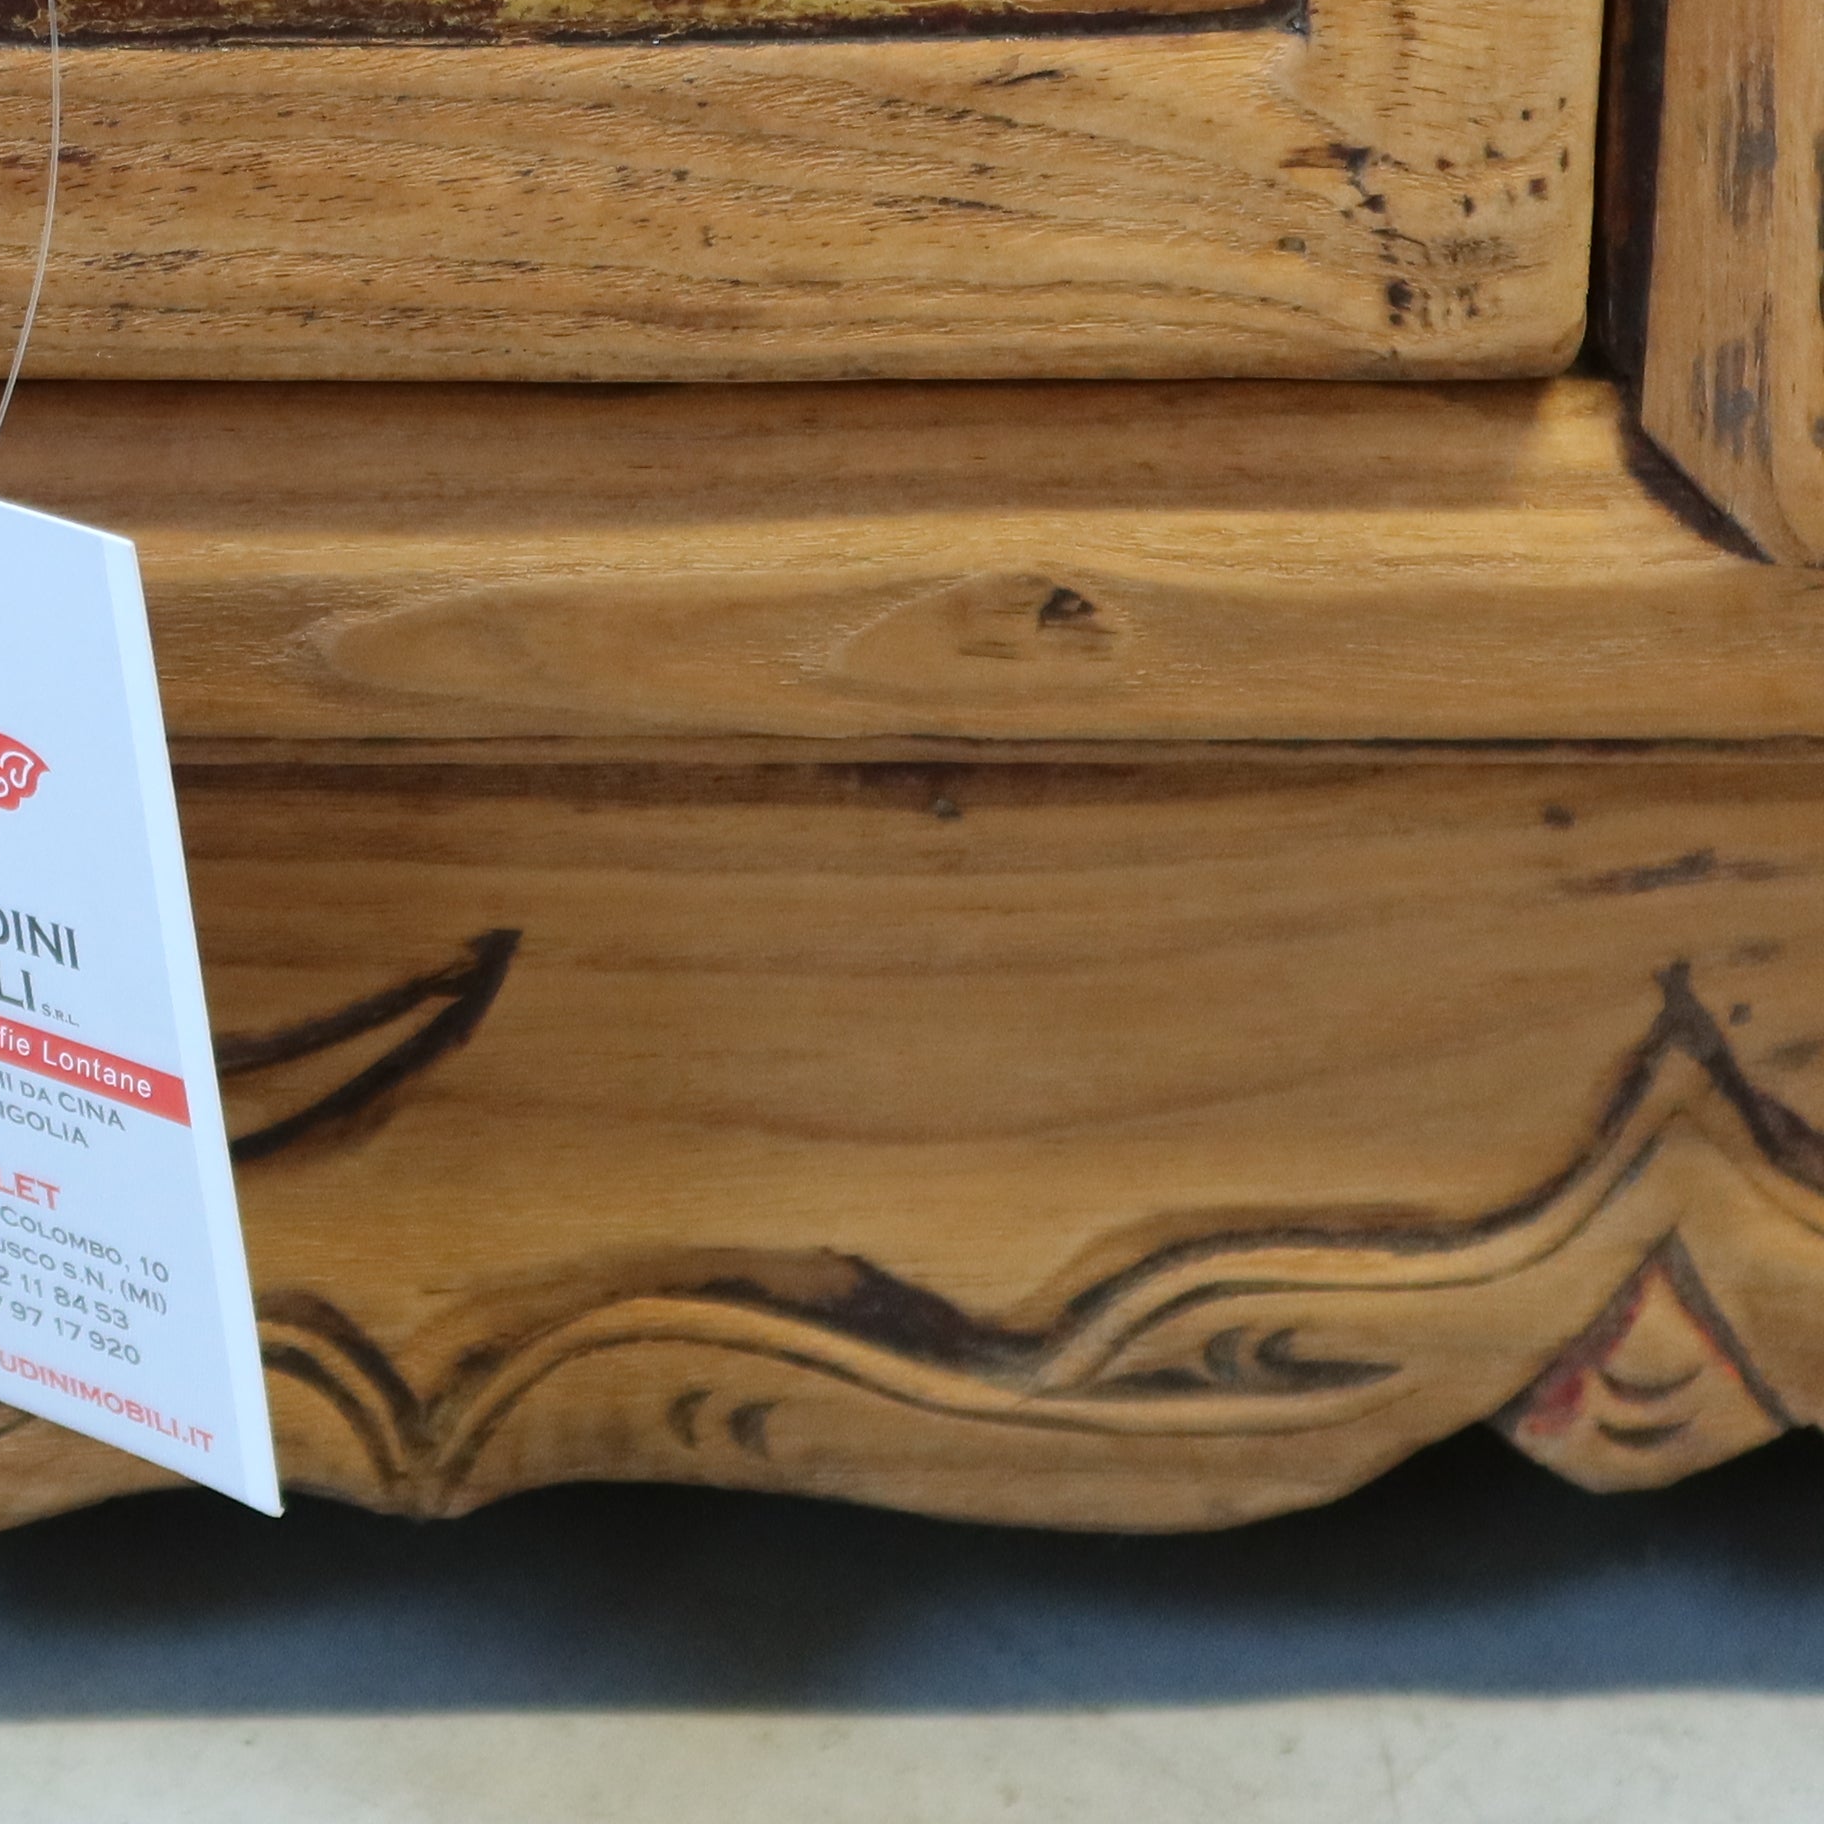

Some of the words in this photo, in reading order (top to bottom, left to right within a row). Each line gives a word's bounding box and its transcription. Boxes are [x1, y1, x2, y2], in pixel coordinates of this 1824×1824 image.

[43, 1039, 153, 1099] Lontane
[20, 1079, 52, 1104] DA
[58, 1090, 125, 1131] CINA
[140, 1256, 170, 1283] 10
[21, 1273, 43, 1298] 11
[53, 1286, 88, 1314] 84
[94, 1300, 129, 1330] 53
[120, 1279, 168, 1316] (MI)
[10, 1301, 42, 1327] 97
[54, 1316, 81, 1341] 17
[88, 1330, 141, 1366] 920
